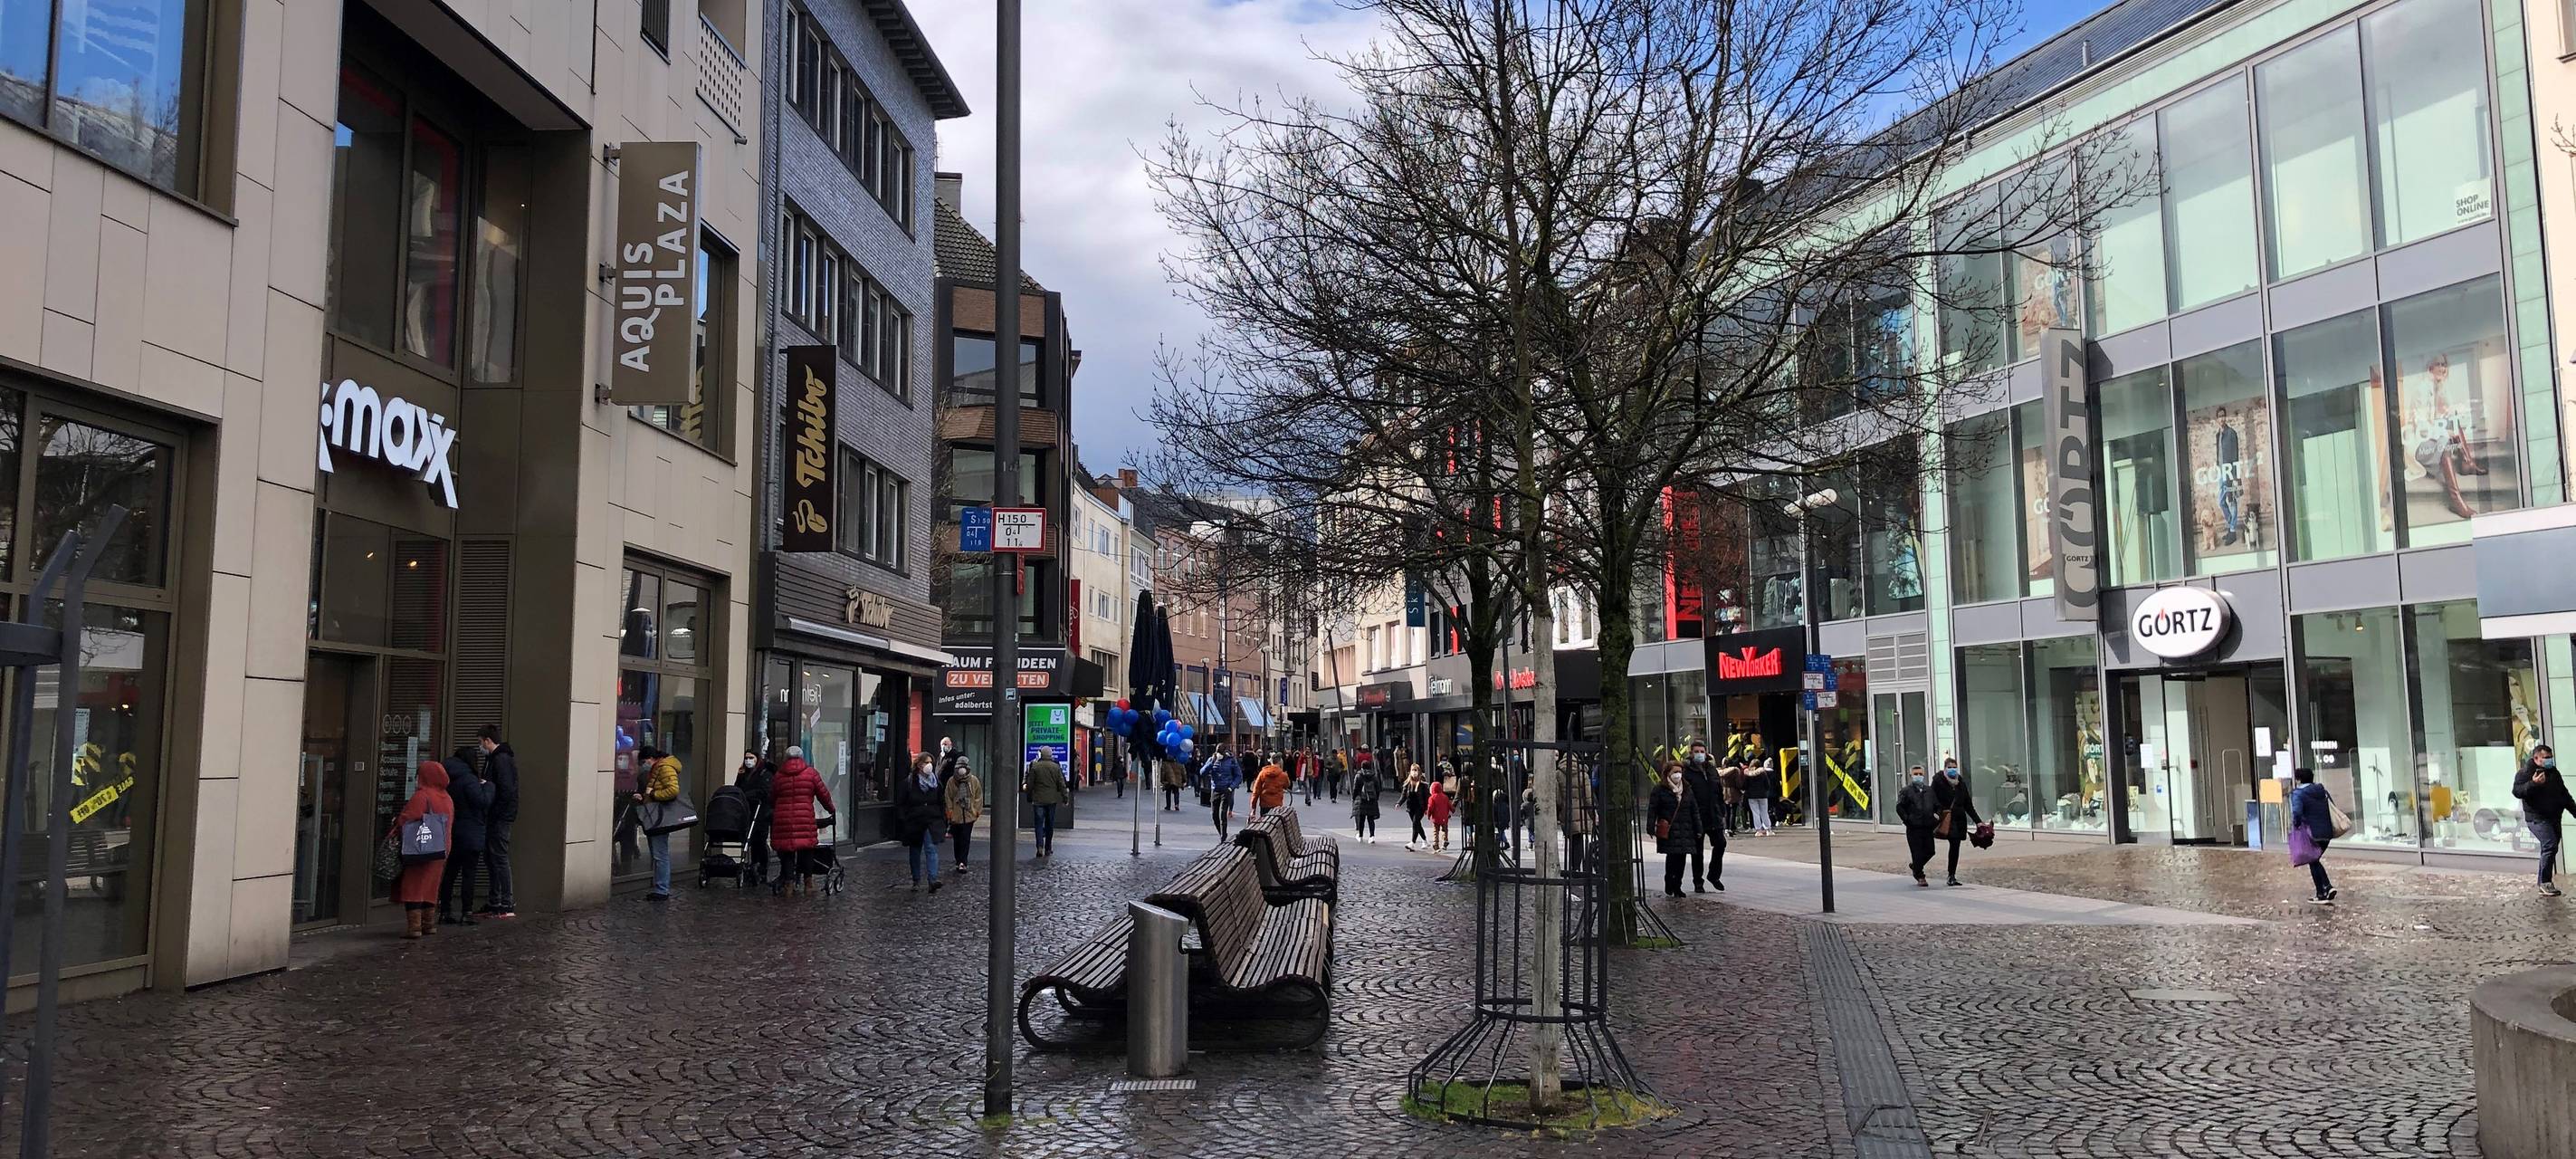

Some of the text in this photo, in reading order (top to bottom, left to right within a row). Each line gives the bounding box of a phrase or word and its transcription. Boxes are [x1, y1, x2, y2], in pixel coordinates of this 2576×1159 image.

[2456, 194, 2479, 208] SHOP
[2457, 199, 2490, 216] ONLINE
[654, 169, 690, 306] PLAZA
[619, 242, 660, 373] AQUIS
[796, 364, 827, 488] Tchibo
[1017, 657, 1057, 669] IDEEN
[949, 674, 968, 685] ZU
[939, 695, 955, 704] Infos
[955, 701, 993, 709] adalbertst
